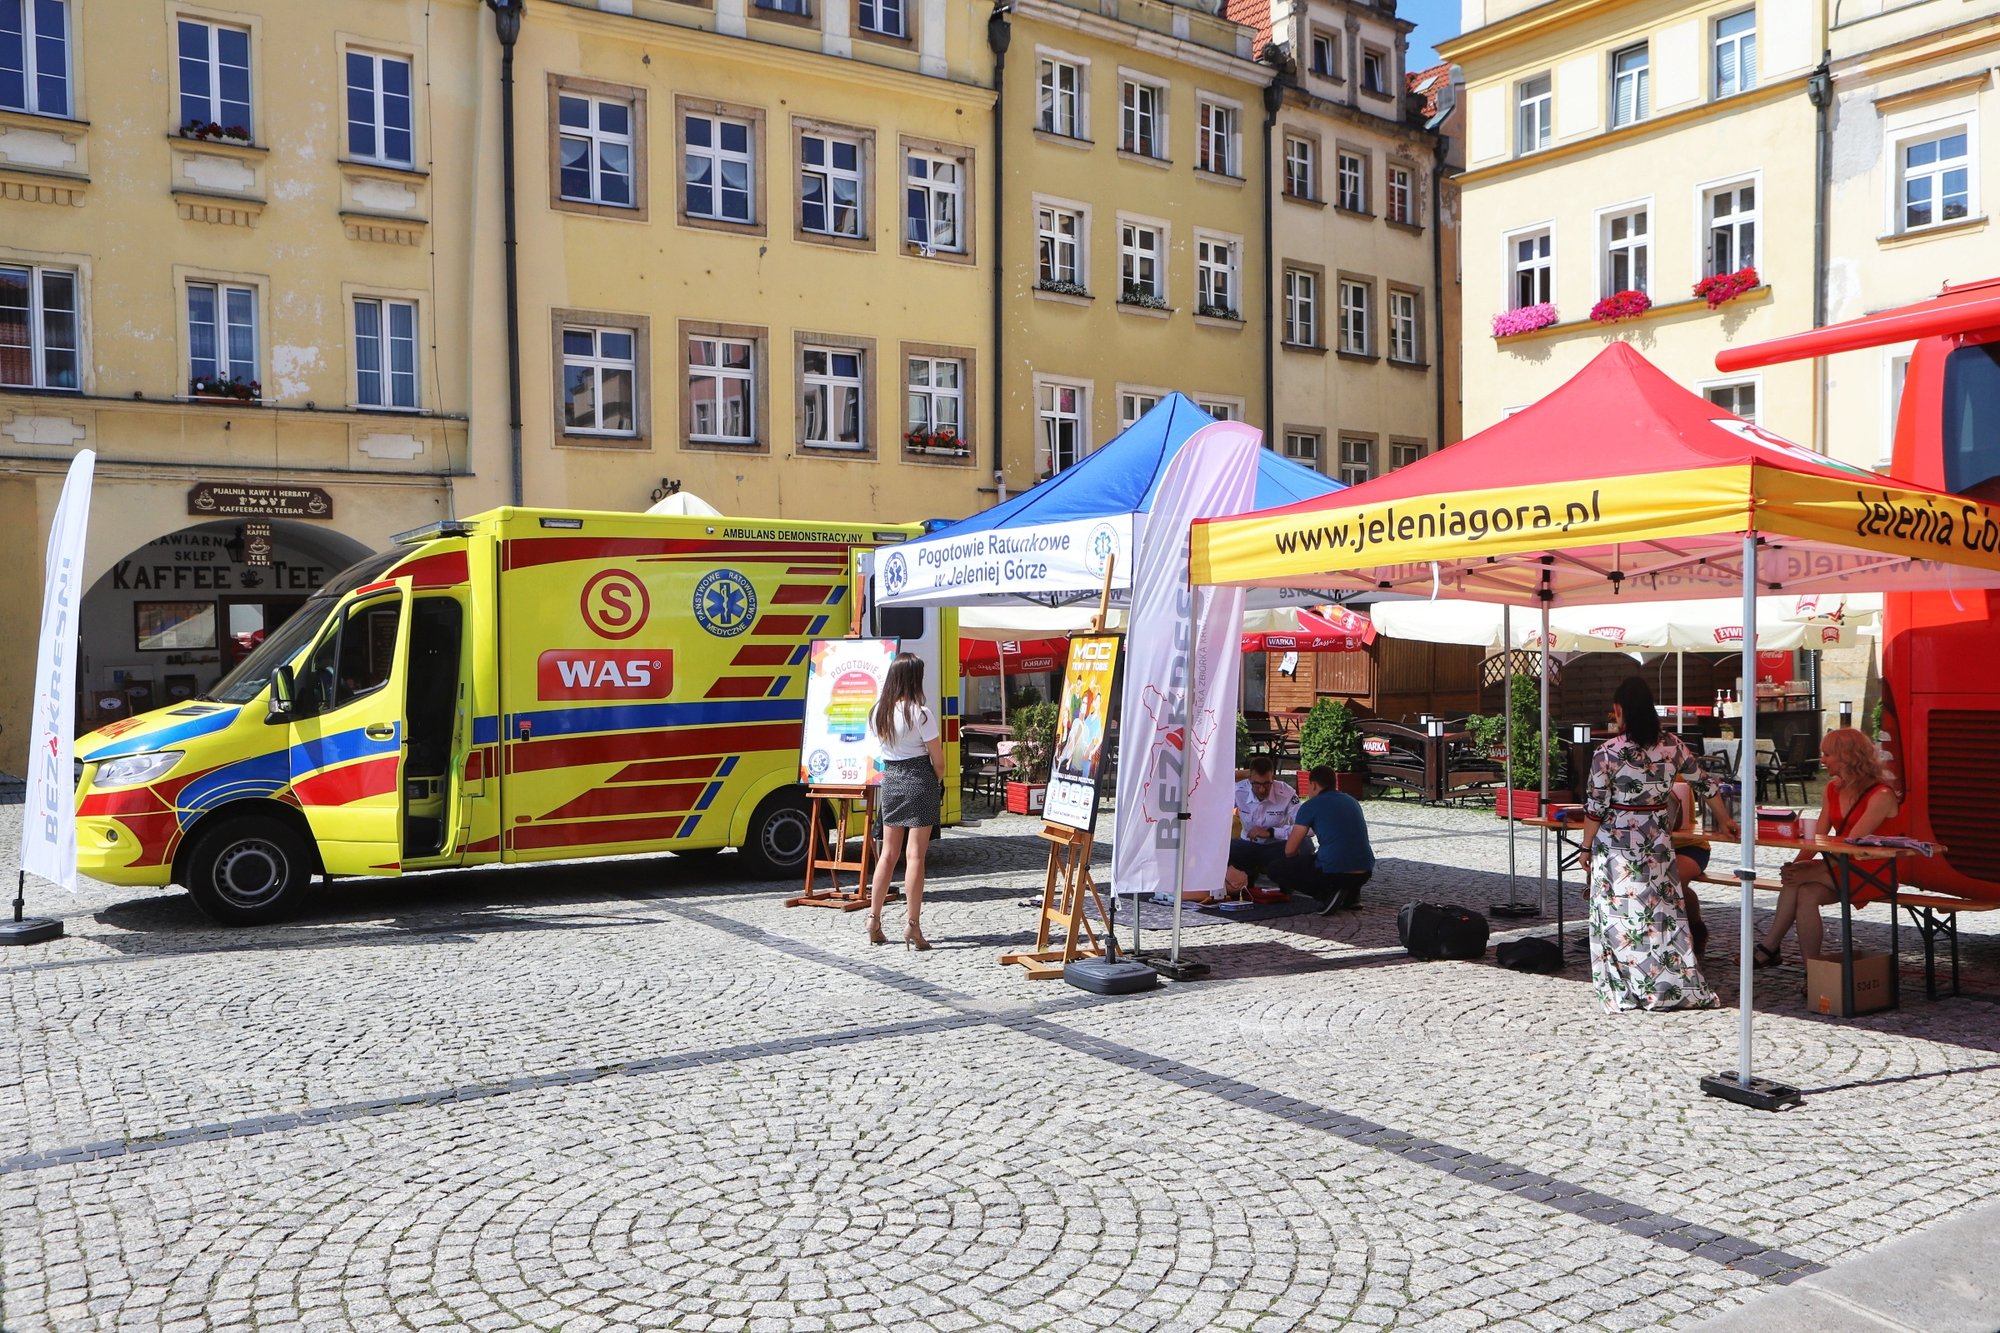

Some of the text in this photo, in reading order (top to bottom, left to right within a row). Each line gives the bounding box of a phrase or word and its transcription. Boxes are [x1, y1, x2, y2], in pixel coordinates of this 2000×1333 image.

[213, 487, 246, 496] PIJALNIA
[249, 489, 270, 497] KAWY
[279, 490, 311, 498] HERBATY
[220, 505, 264, 514] KAFFEEBAR
[275, 507, 304, 515] TEEBAR
[1275, 490, 1600, 554] www.jeleniagora.pl
[1857, 491, 2000, 553] Jelenia Gó
[723, 528, 863, 543] AMBULANS DEMONSTRACYJNY
[175, 551, 216, 561] SKLEP
[918, 539, 985, 567] Pogotowie
[988, 533, 1071, 555] Ratunkowe
[113, 560, 324, 589] KAFFEE TEE
[934, 559, 1048, 587] w Jeleniej Górze
[728, 571, 756, 620] RATOWNICTWO
[599, 583, 631, 626] S
[706, 622, 747, 636] MEDYCZNE
[1718, 627, 1743, 639] ŻYWI
[1267, 637, 1295, 647] WARKA
[1073, 643, 1112, 660] MOC
[830, 660, 879, 679] POGOTOWIE
[1362, 740, 1387, 752] WARKA
[1489, 747, 1508, 757] WAR
[842, 770, 858, 780] 999
